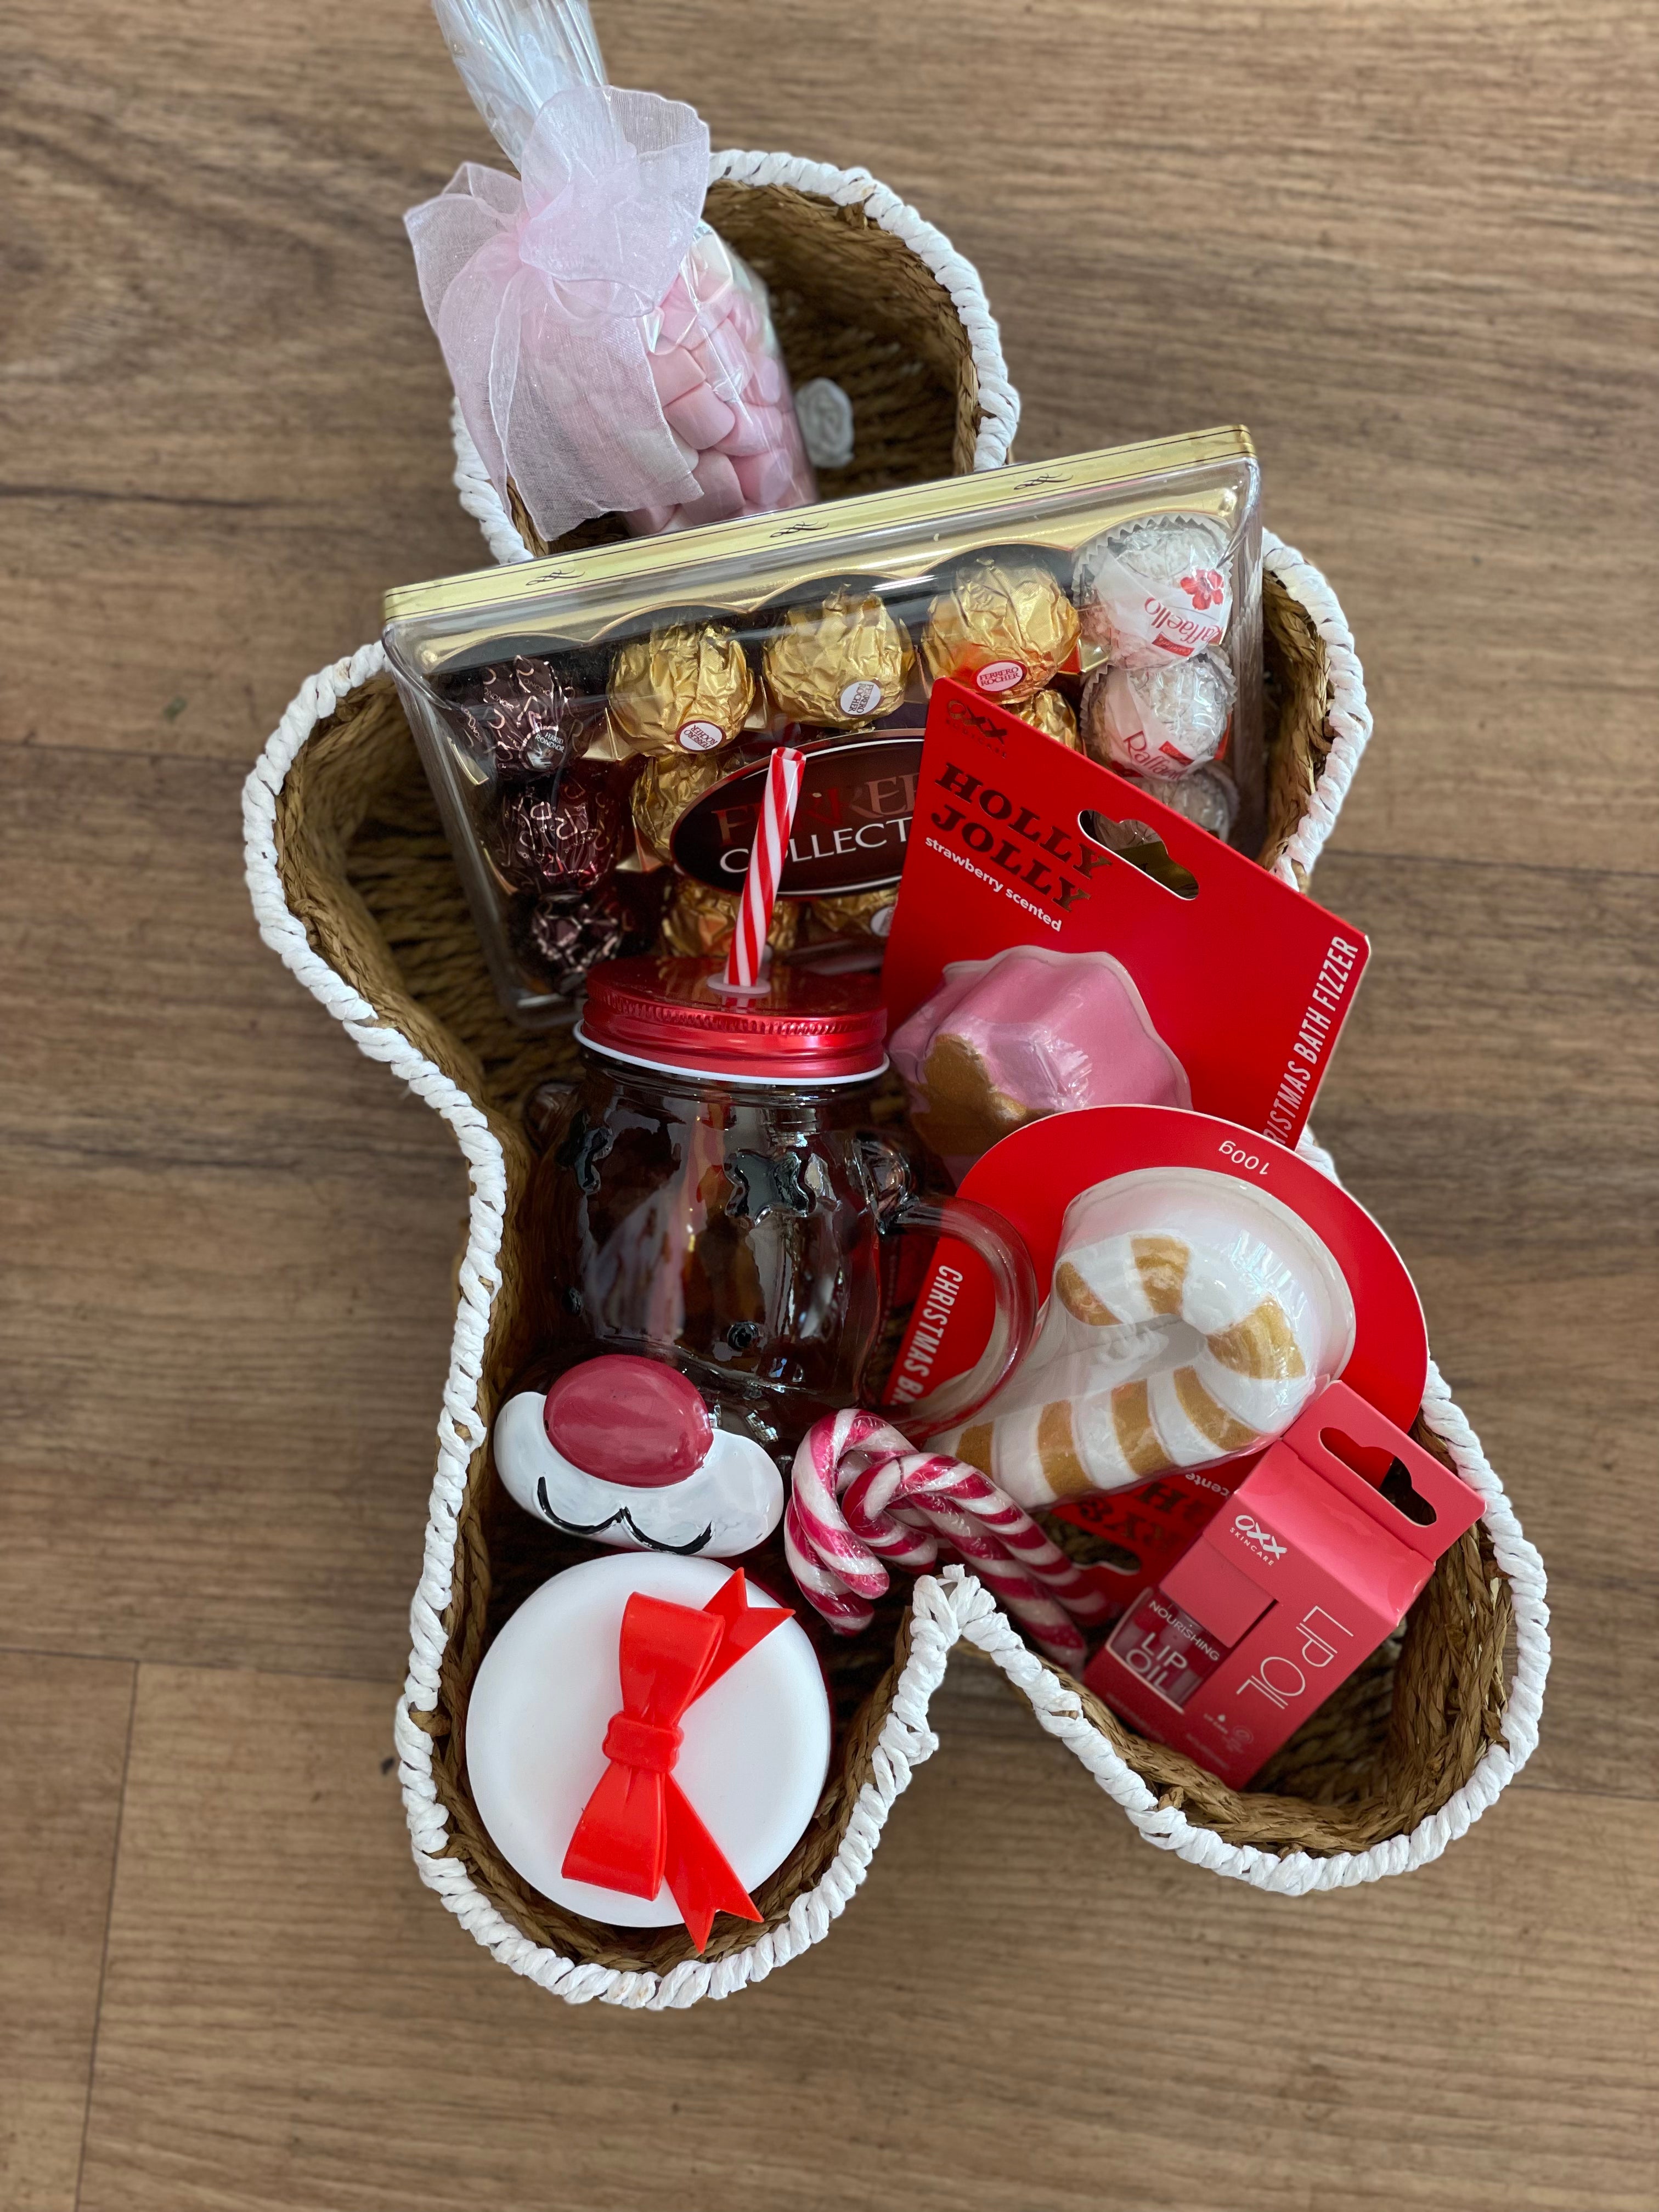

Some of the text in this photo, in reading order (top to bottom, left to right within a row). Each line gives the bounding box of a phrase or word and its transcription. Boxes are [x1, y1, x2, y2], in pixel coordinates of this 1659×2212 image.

[979, 667, 1019, 681] FERRERO
[980, 673, 1020, 686] ROCHER
[848, 683, 866, 712] ROCHER
[856, 684, 874, 713] FERRERO
[684, 730, 711, 749] FERRERO
[691, 725, 718, 746] ROCHER
[935, 763, 1112, 879] HOLLY
[931, 804, 1092, 912] JOLLY
[926, 837, 1062, 932] strawberry scented
[1263, 936, 1358, 1145] RISTMAS BATH FIZZER
[1218, 1141, 1269, 1175] 100g
[890, 1265, 963, 1405] CHRISTMAS BA
[1185, 1473, 1232, 1499] cente
[1229, 1527, 1274, 1566] SKINCARE
[1235, 1515, 1288, 1560] OXX
[1149, 1600, 1220, 1661] NOURISHING
[1141, 1632, 1188, 1669] LIP
[1236, 1605, 1354, 1709] LIP OIL
[1126, 1649, 1169, 1695] OIL
